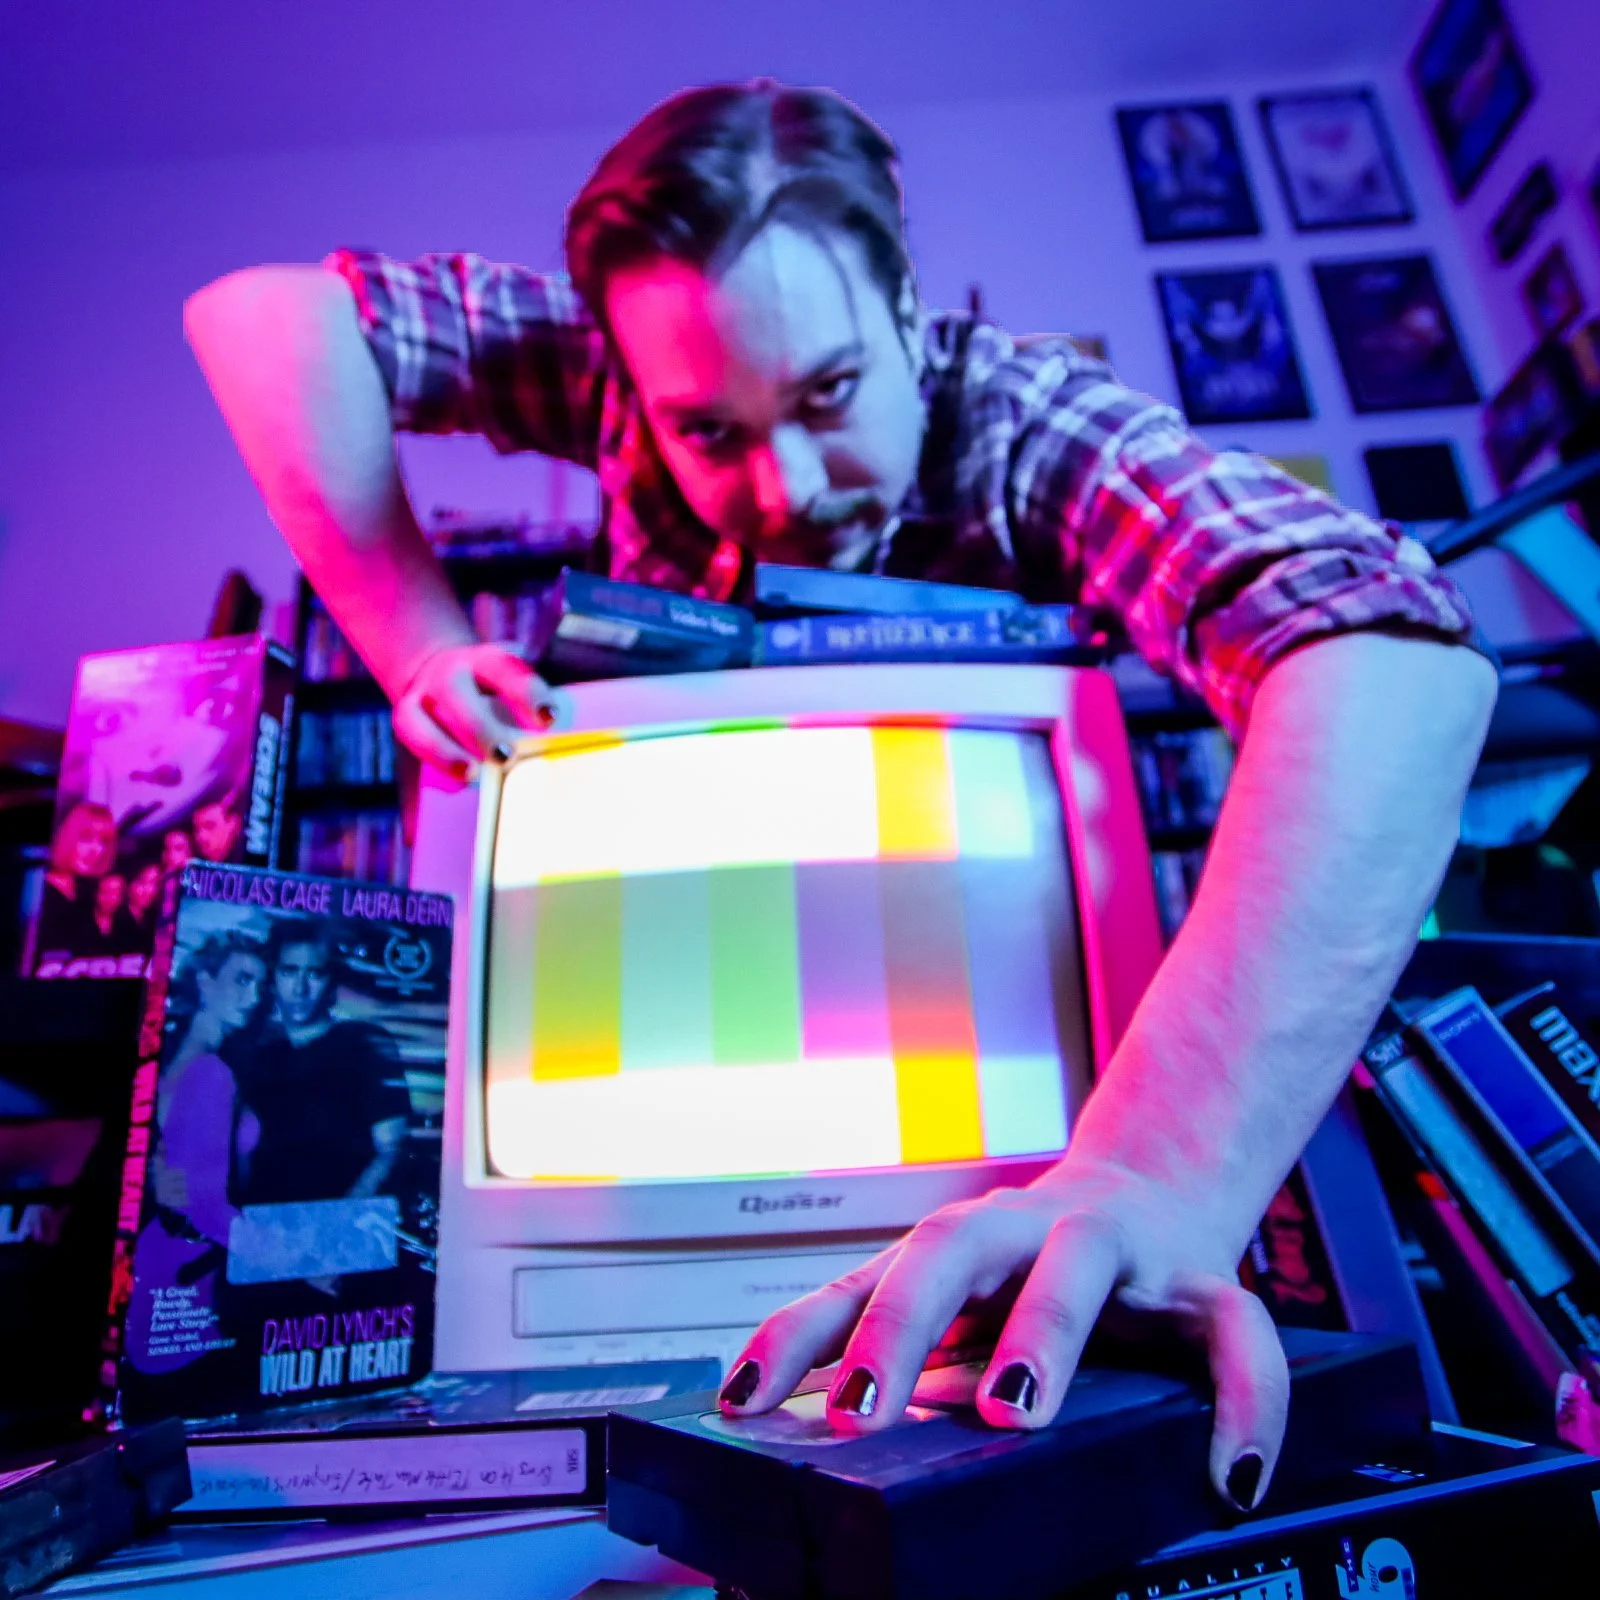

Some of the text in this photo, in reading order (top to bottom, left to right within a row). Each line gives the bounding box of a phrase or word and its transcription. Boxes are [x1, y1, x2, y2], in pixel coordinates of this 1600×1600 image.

[246, 713, 281, 855] SCREAM
[187, 870, 451, 926] NICOLAS CAGE LAURA DERN
[1529, 1005, 1600, 1114] max
[738, 1192, 845, 1214] Quasar
[150, 1321, 176, 1332] Love
[262, 1304, 416, 1355] DAVID LYNCH'S
[260, 1337, 415, 1395] WILD AT HEART
